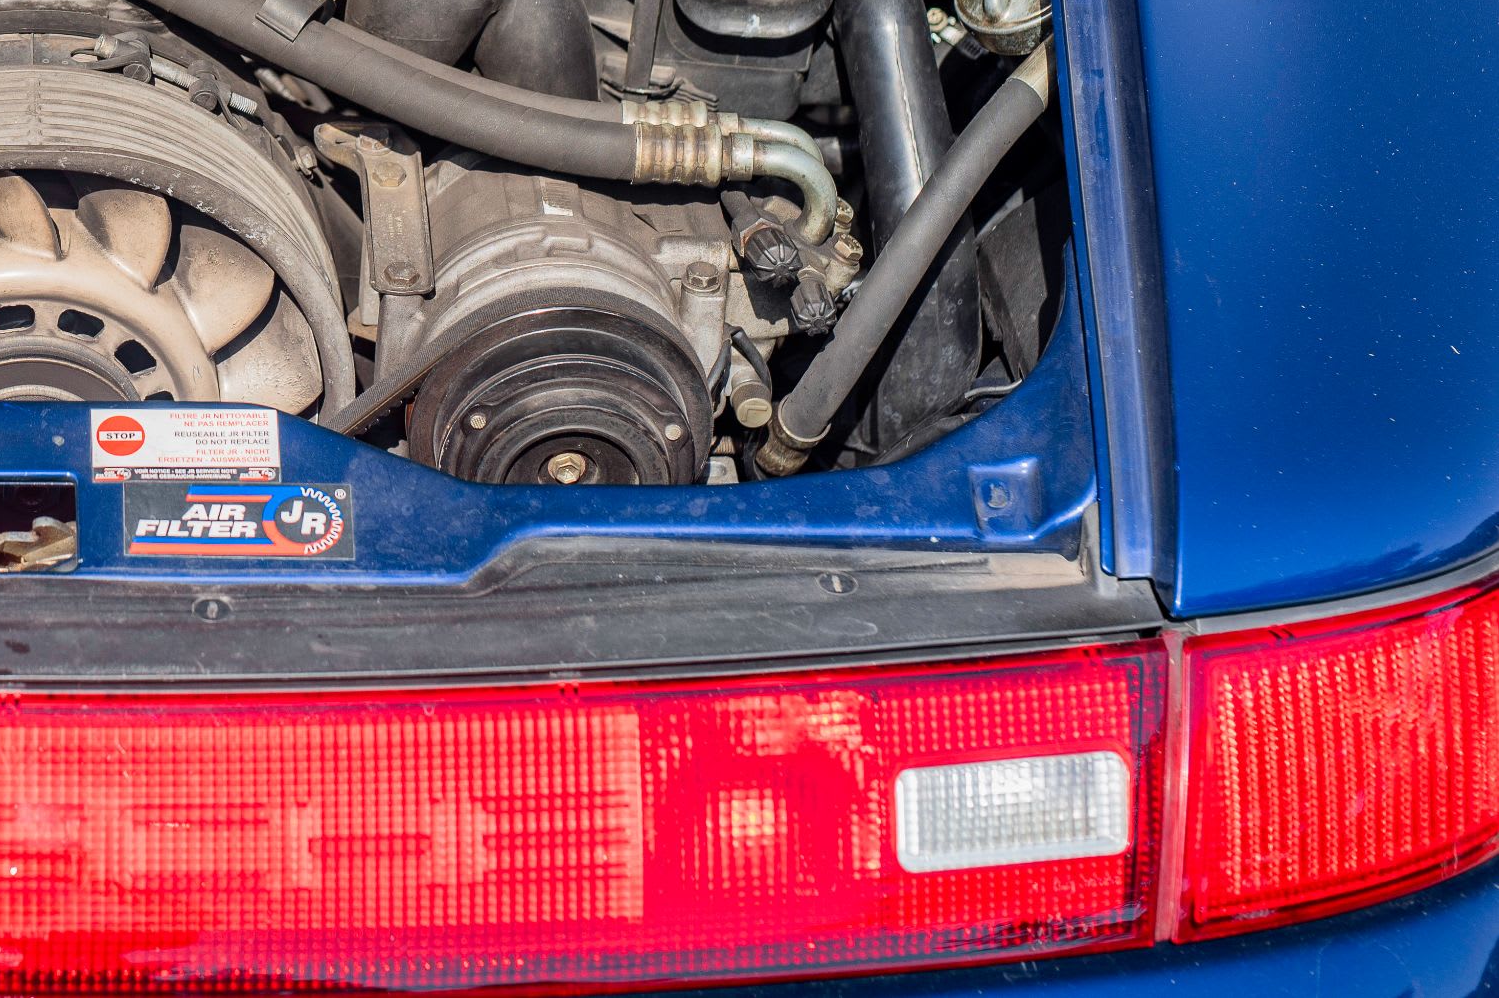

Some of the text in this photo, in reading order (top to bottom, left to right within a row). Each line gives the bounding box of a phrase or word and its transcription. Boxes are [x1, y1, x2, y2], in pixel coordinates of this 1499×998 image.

[170, 412, 268, 420] FILTRE JR NETTOYABLE
[106, 432, 136, 440] STOP
[174, 430, 270, 438] REUSEABLE JR FILTER
[196, 438, 270, 446] DO NOT REPLACE
[196, 448, 224, 456] FILTER
[226, 448, 238, 456] JR
[244, 448, 270, 456] NICHT
[158, 456, 203, 464] ERSETZEN
[210, 456, 271, 464] AUSWASCBAR
[182, 504, 246, 520] AIR
[135, 520, 258, 538] FILTER
